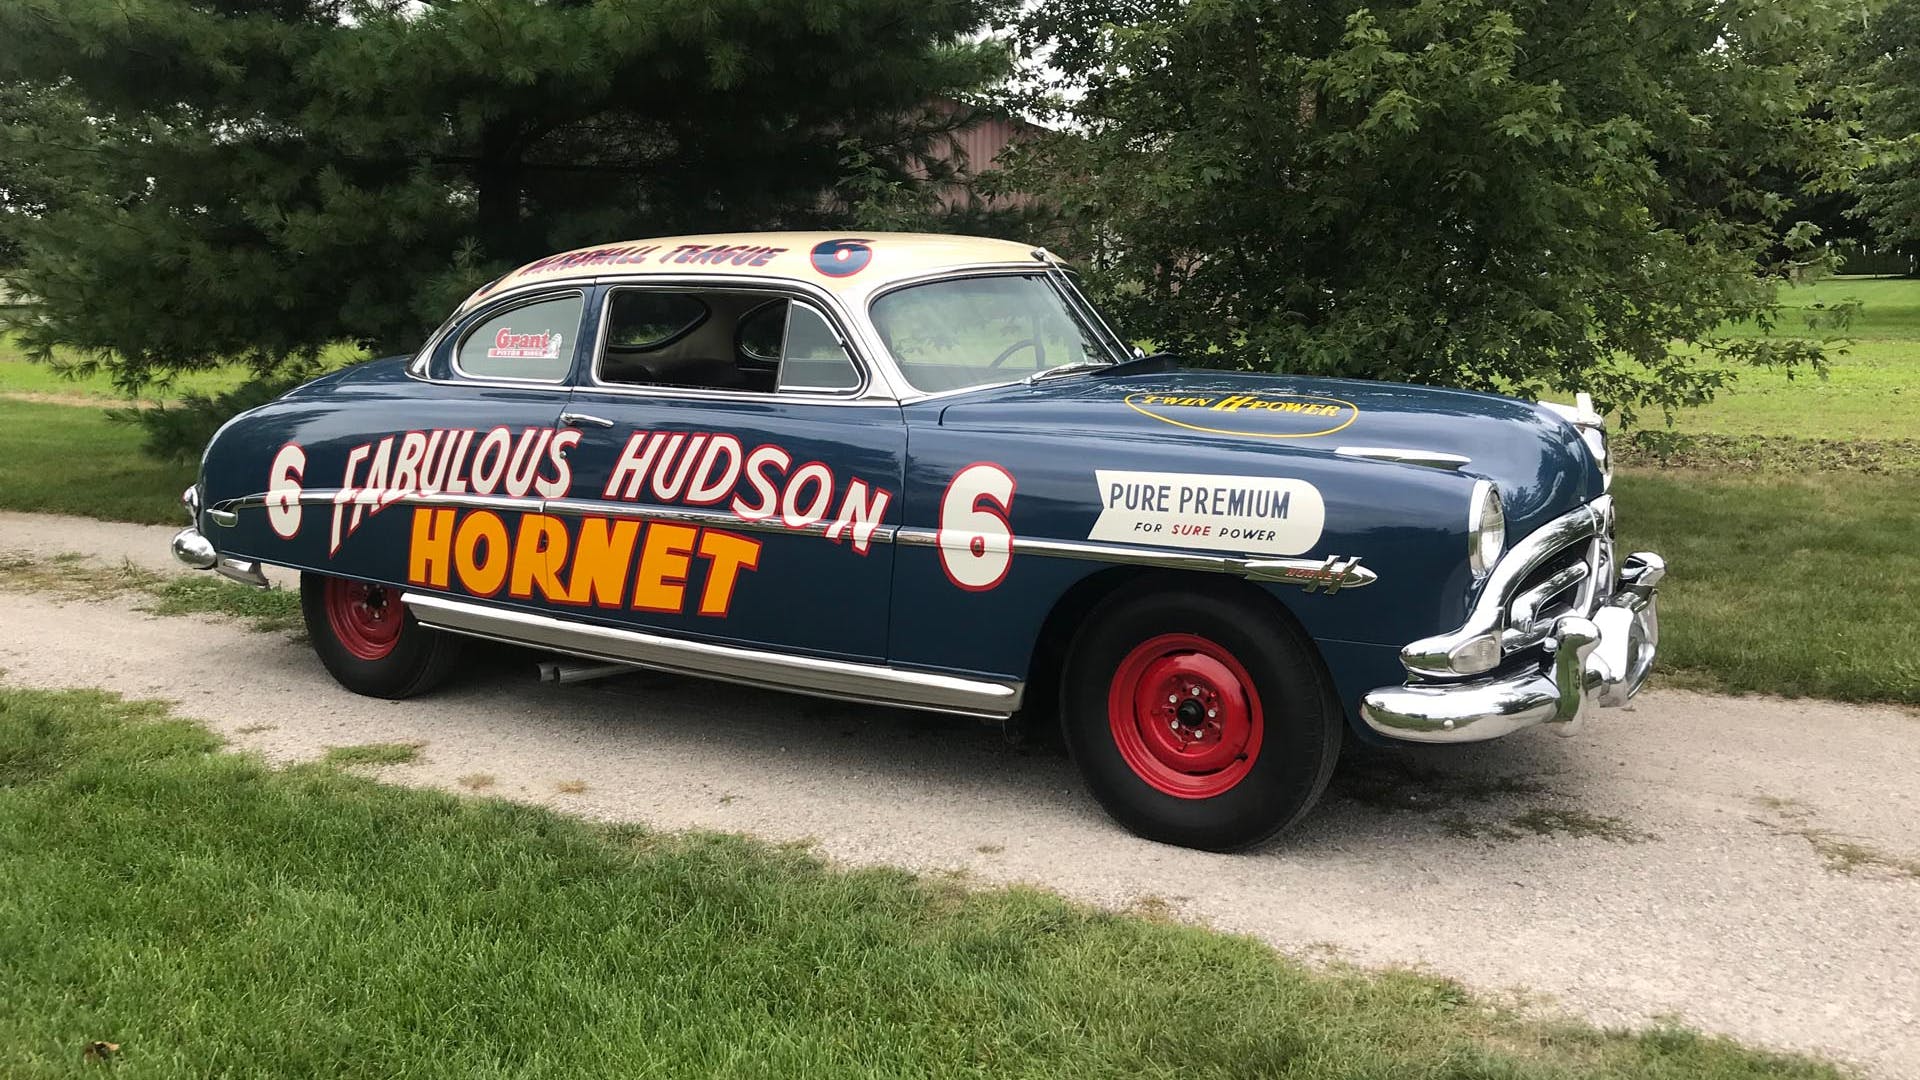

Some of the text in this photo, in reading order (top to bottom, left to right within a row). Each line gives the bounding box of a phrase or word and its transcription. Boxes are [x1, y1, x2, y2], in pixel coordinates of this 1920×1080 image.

[658, 244, 788, 267] TEAGUE
[810, 238, 877, 278] 6
[496, 328, 550, 349] Grant
[1141, 394, 1216, 407] TWIN
[265, 441, 306, 540] 6
[329, 425, 892, 558] FABULOUS HUDSON
[1109, 483, 1291, 519] PURE PREMIUM
[936, 461, 1017, 592] 6
[1134, 522, 1276, 541] FOR SURE POWER
[408, 507, 763, 618] HORNET
